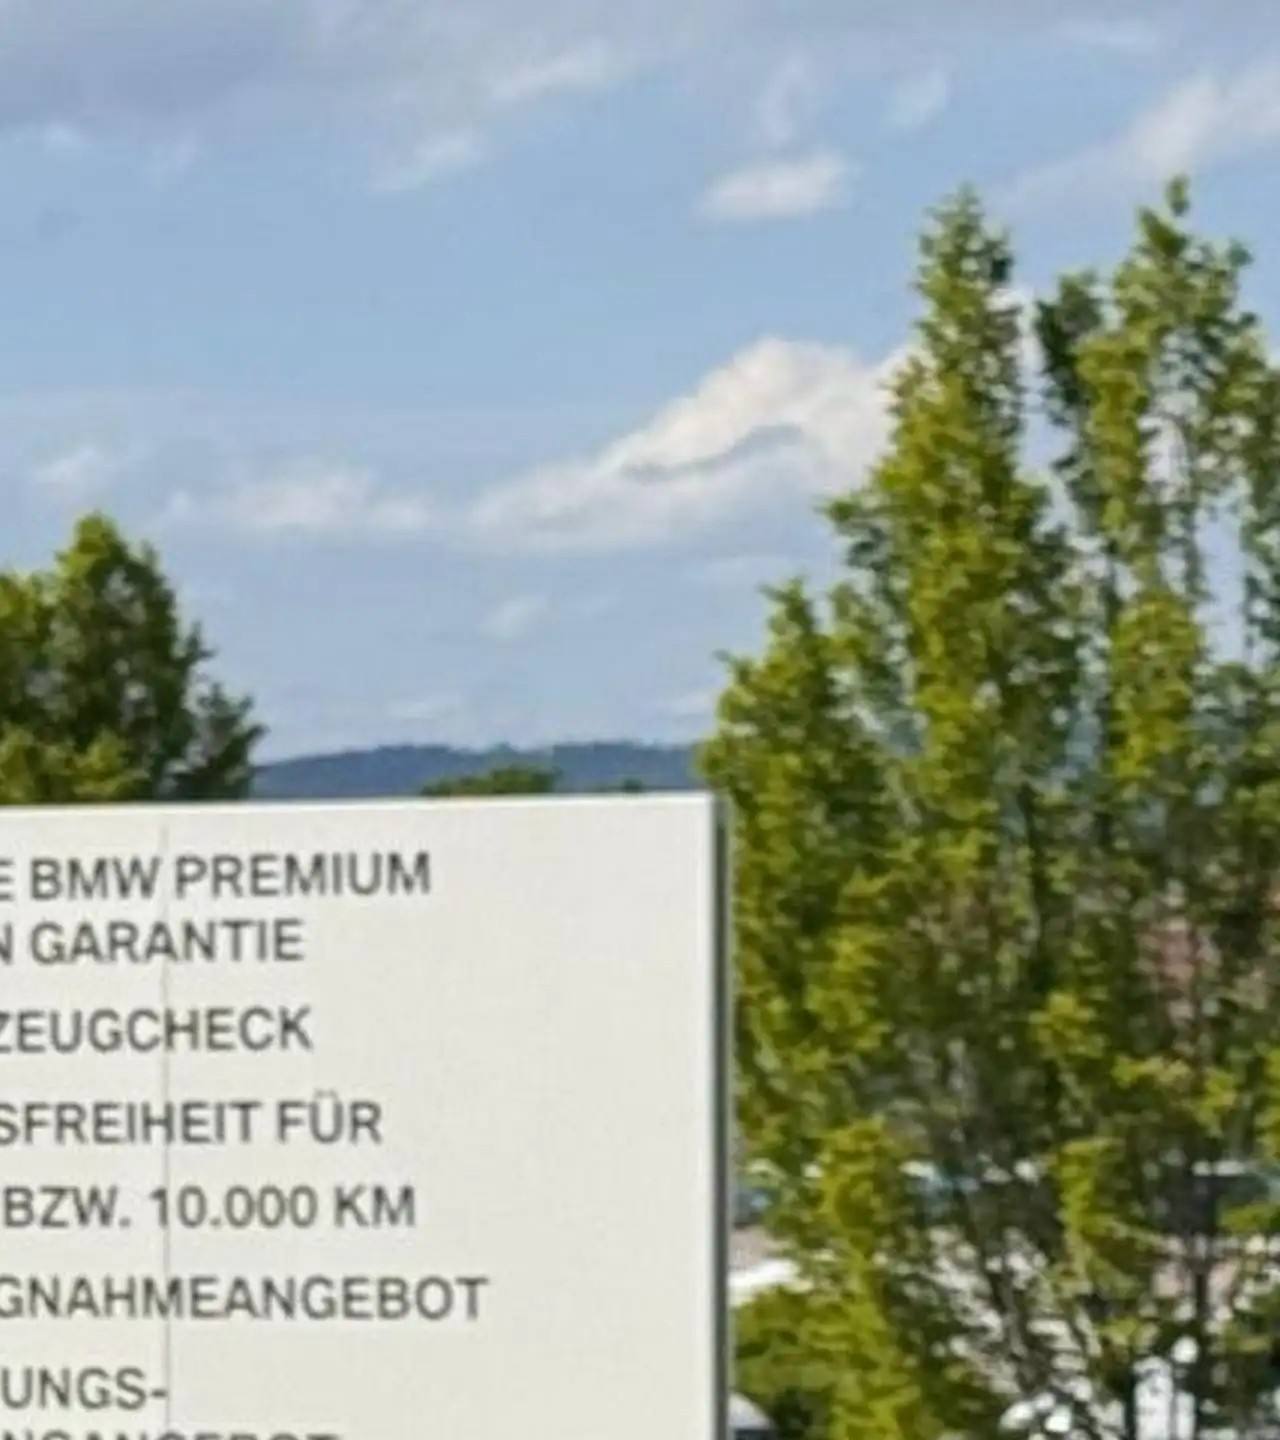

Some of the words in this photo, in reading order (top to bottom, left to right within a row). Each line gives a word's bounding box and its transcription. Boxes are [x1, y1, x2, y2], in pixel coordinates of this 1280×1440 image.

[30, 856, 162, 901] BMW
[175, 851, 430, 897] PREMIUM
[30, 918, 303, 965] GARANTIE
[277, 1091, 382, 1144] FÜR
[3, 1186, 132, 1230] BZW.
[150, 1185, 319, 1229] 10.000
[334, 1185, 416, 1228] KM
